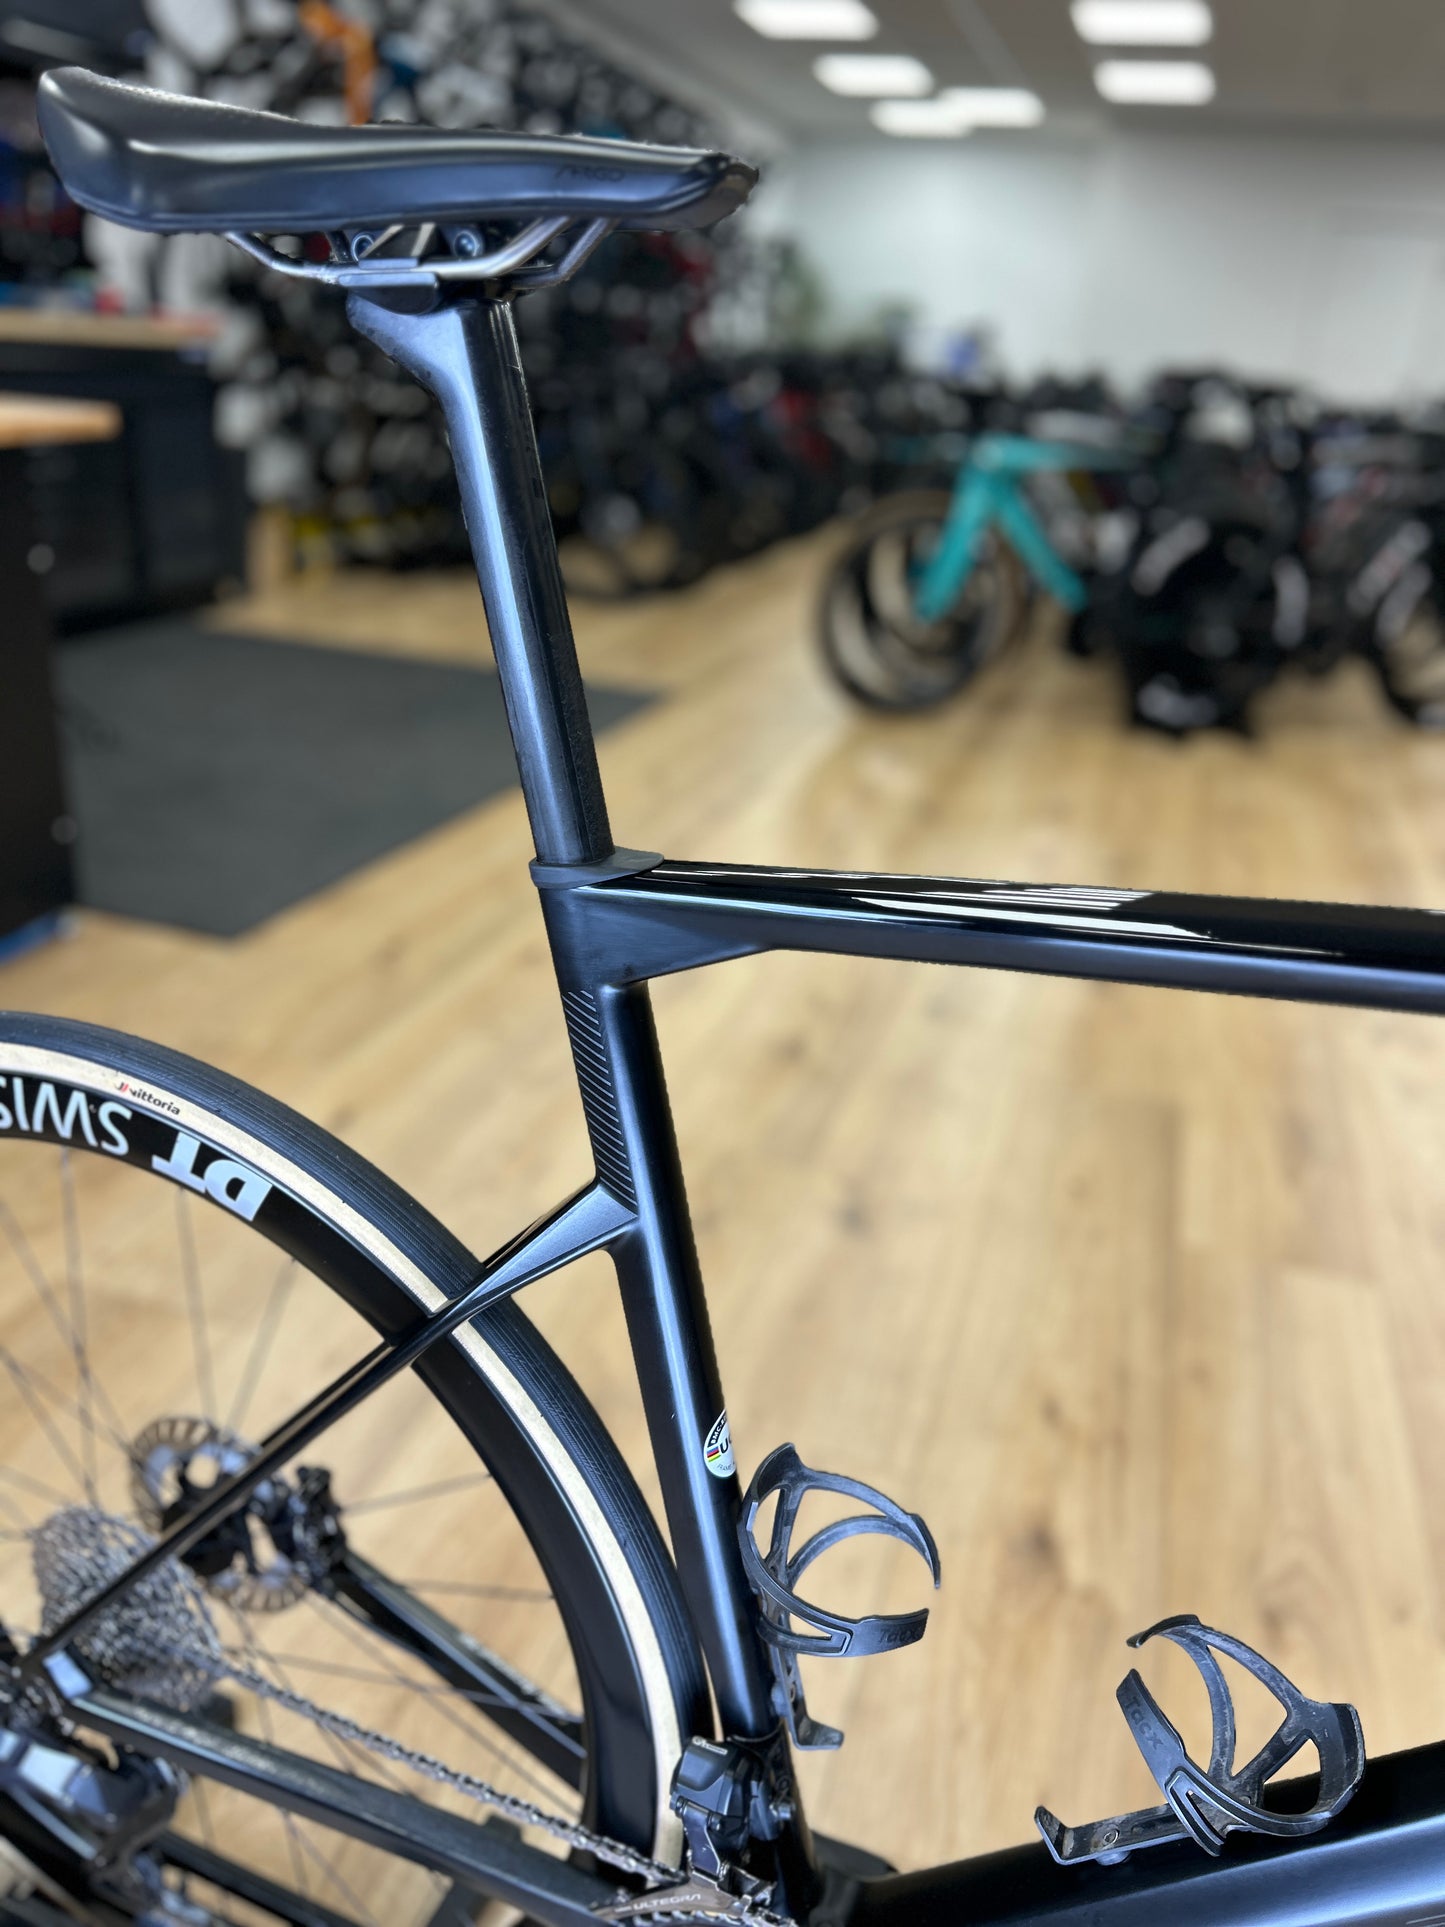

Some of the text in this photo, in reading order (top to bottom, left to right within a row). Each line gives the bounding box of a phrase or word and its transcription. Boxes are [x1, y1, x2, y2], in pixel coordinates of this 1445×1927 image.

[129, 1088, 181, 1116] vittoria
[151, 1131, 273, 1222] DT
[1124, 1694, 1164, 1750] Tacx
[633, 1893, 702, 1911] ULTEGRA
